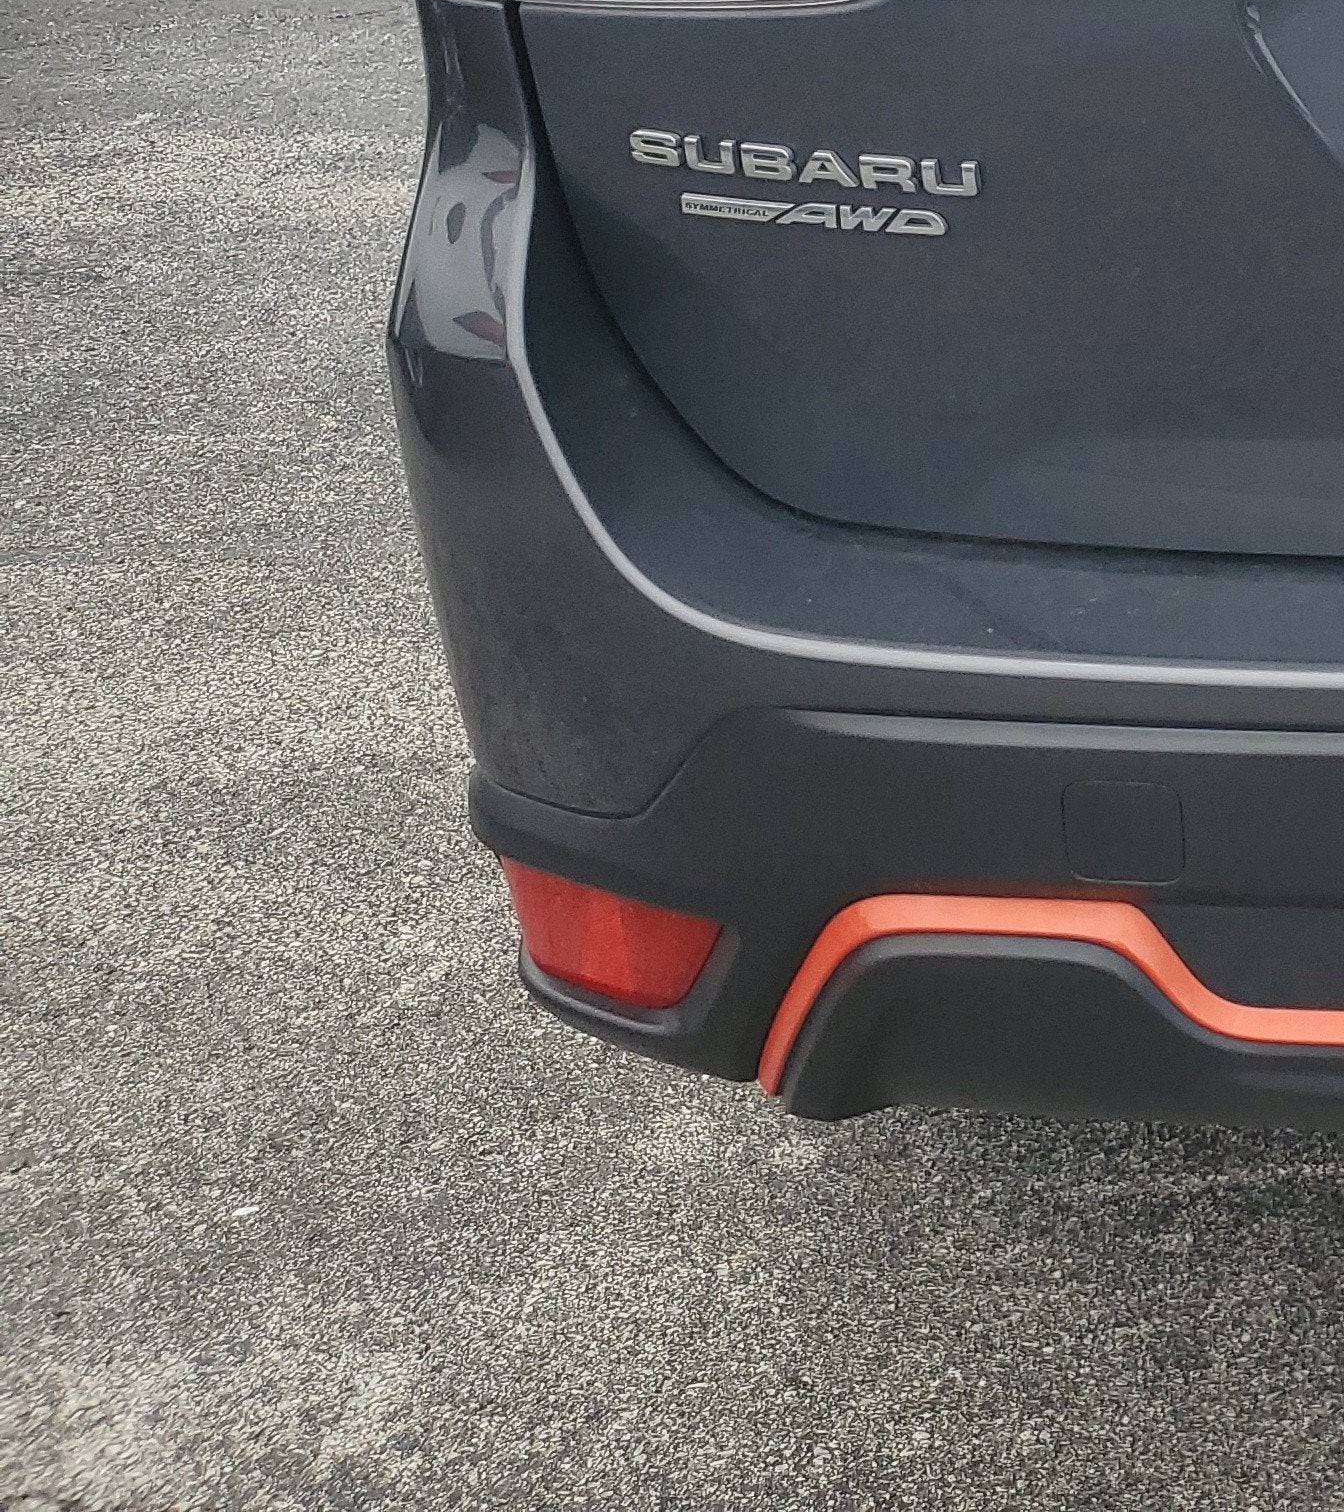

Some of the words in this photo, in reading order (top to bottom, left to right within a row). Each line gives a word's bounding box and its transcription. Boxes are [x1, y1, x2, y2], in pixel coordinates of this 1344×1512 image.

[629, 127, 983, 197] SUBARU
[684, 201, 769, 217] SYMMETRICAL
[775, 201, 949, 237] AWD
